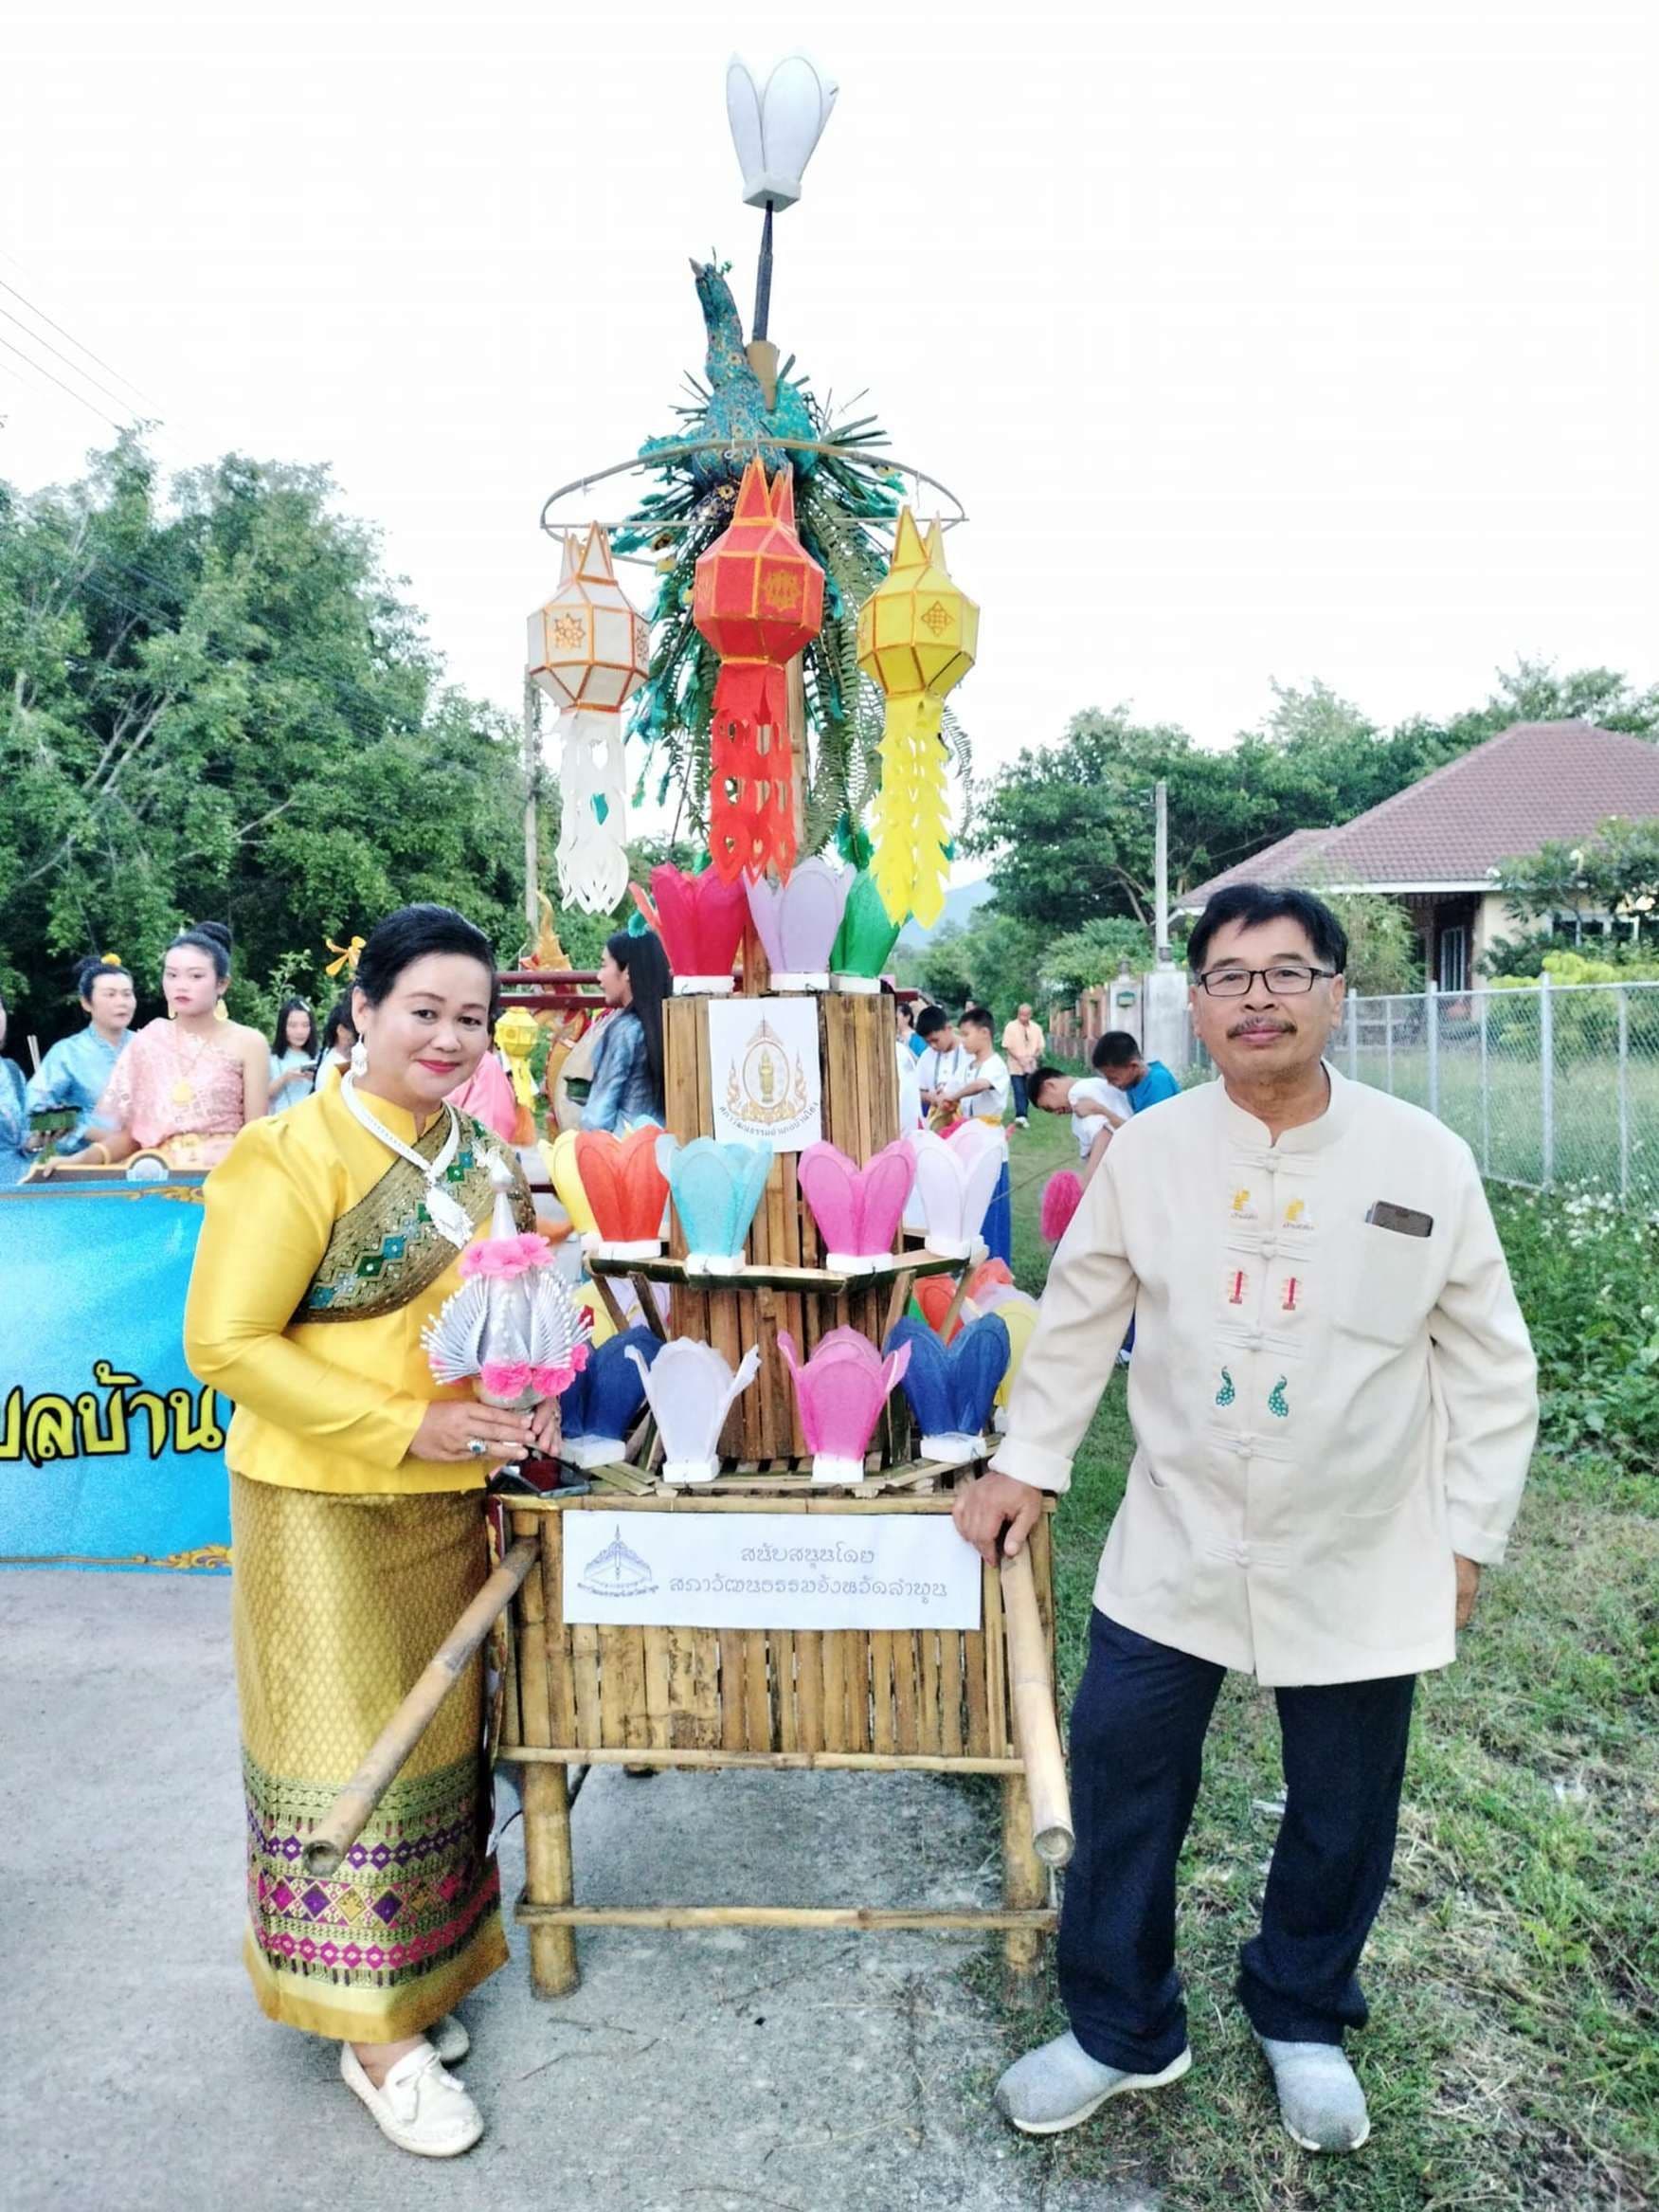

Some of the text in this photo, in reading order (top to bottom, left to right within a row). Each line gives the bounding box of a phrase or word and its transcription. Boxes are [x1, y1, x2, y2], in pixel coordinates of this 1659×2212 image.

[741, 1541, 875, 1568] สนับสนุนโดย
[669, 1572, 948, 1604] สภาวัฒนธรรมจังหวัดลำพูน
